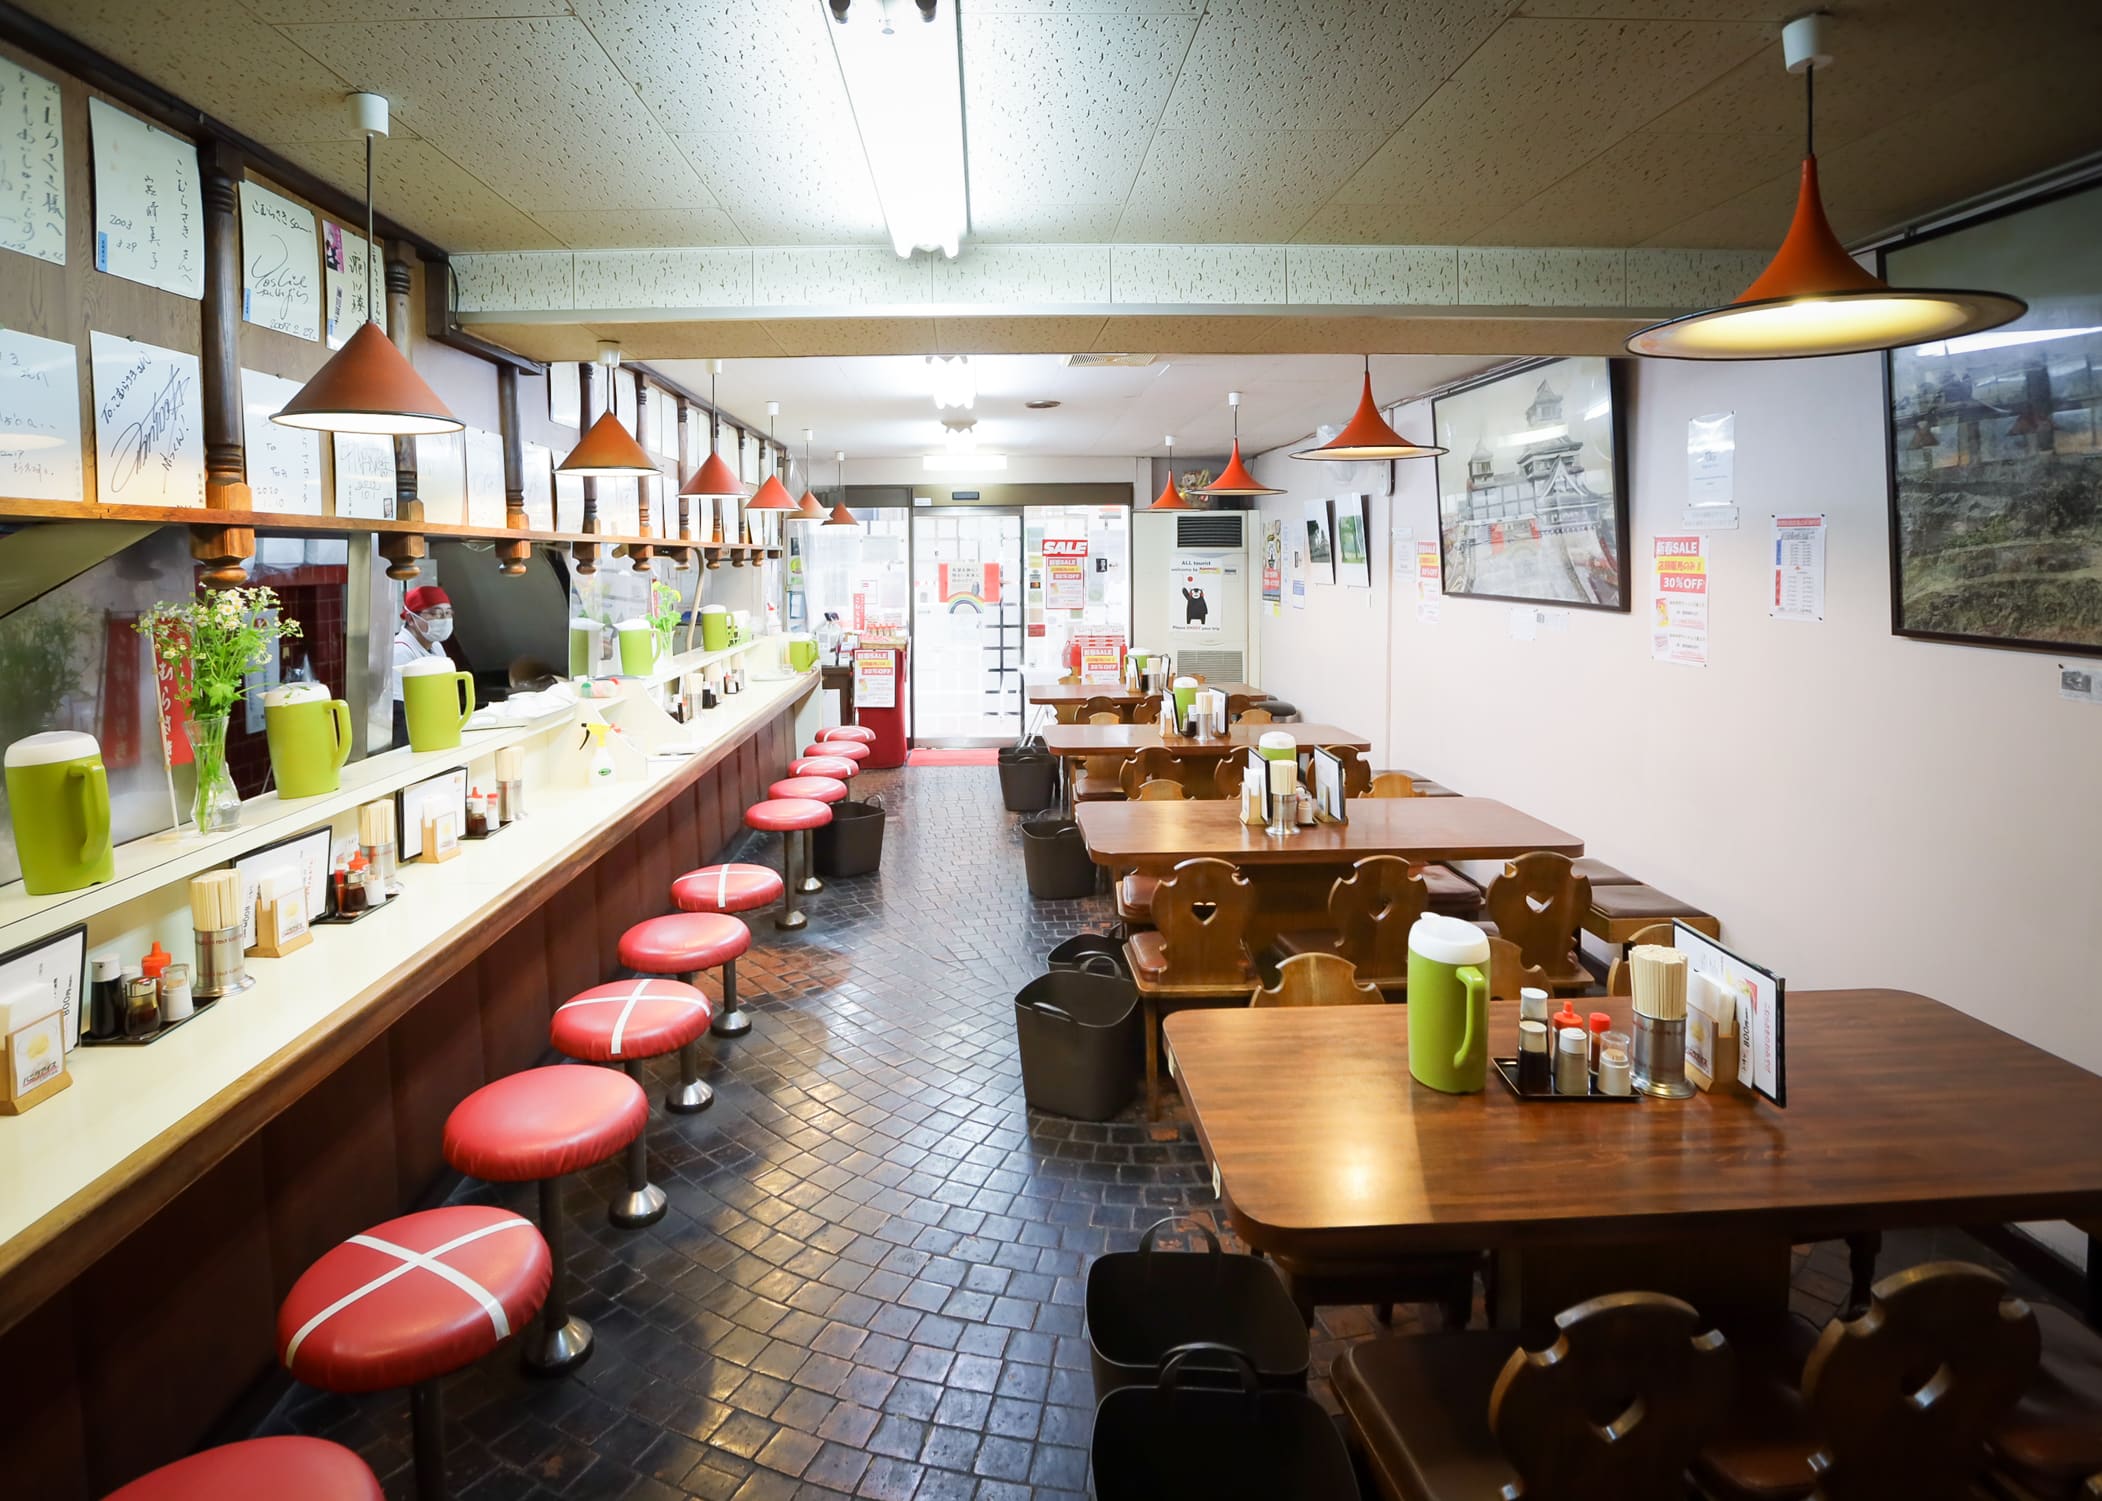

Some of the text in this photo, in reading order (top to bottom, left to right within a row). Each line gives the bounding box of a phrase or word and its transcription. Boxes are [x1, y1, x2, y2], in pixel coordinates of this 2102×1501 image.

[109, 213, 133, 231] 2003
[1043, 541, 1087, 554] SALE
[1663, 577, 1704, 590] 30%OFF
